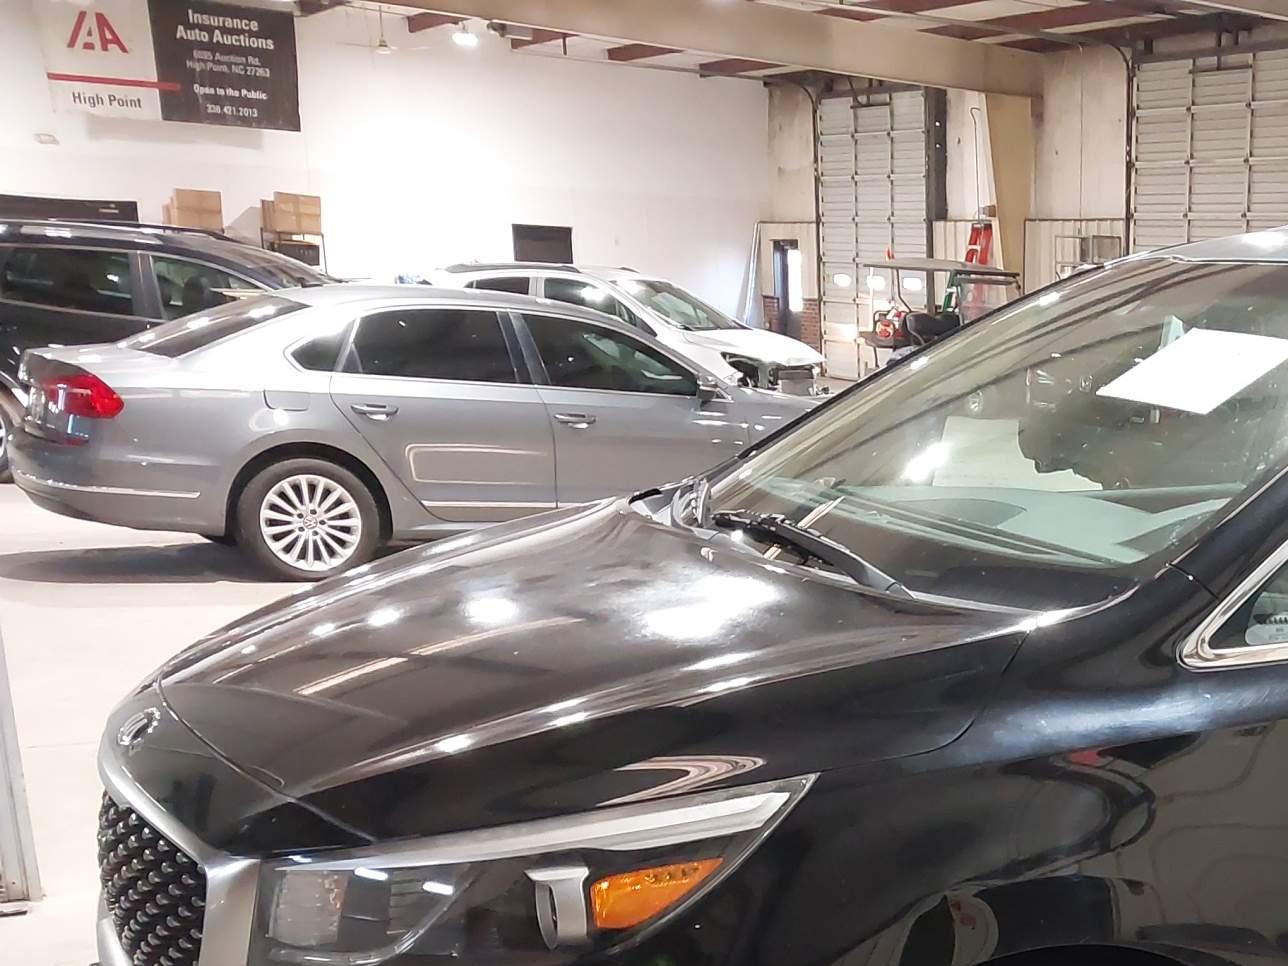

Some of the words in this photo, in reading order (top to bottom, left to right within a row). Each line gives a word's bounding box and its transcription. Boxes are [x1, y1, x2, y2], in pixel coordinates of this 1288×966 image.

[188, 9, 259, 31] Insurance
[176, 25, 209, 42] Auto
[212, 29, 275, 50] Auctions
[231, 65, 245, 75] NC
[72, 91, 104, 108] High
[108, 94, 142, 108] Point
[193, 84, 215, 96] Open
[241, 89, 268, 100] Public
